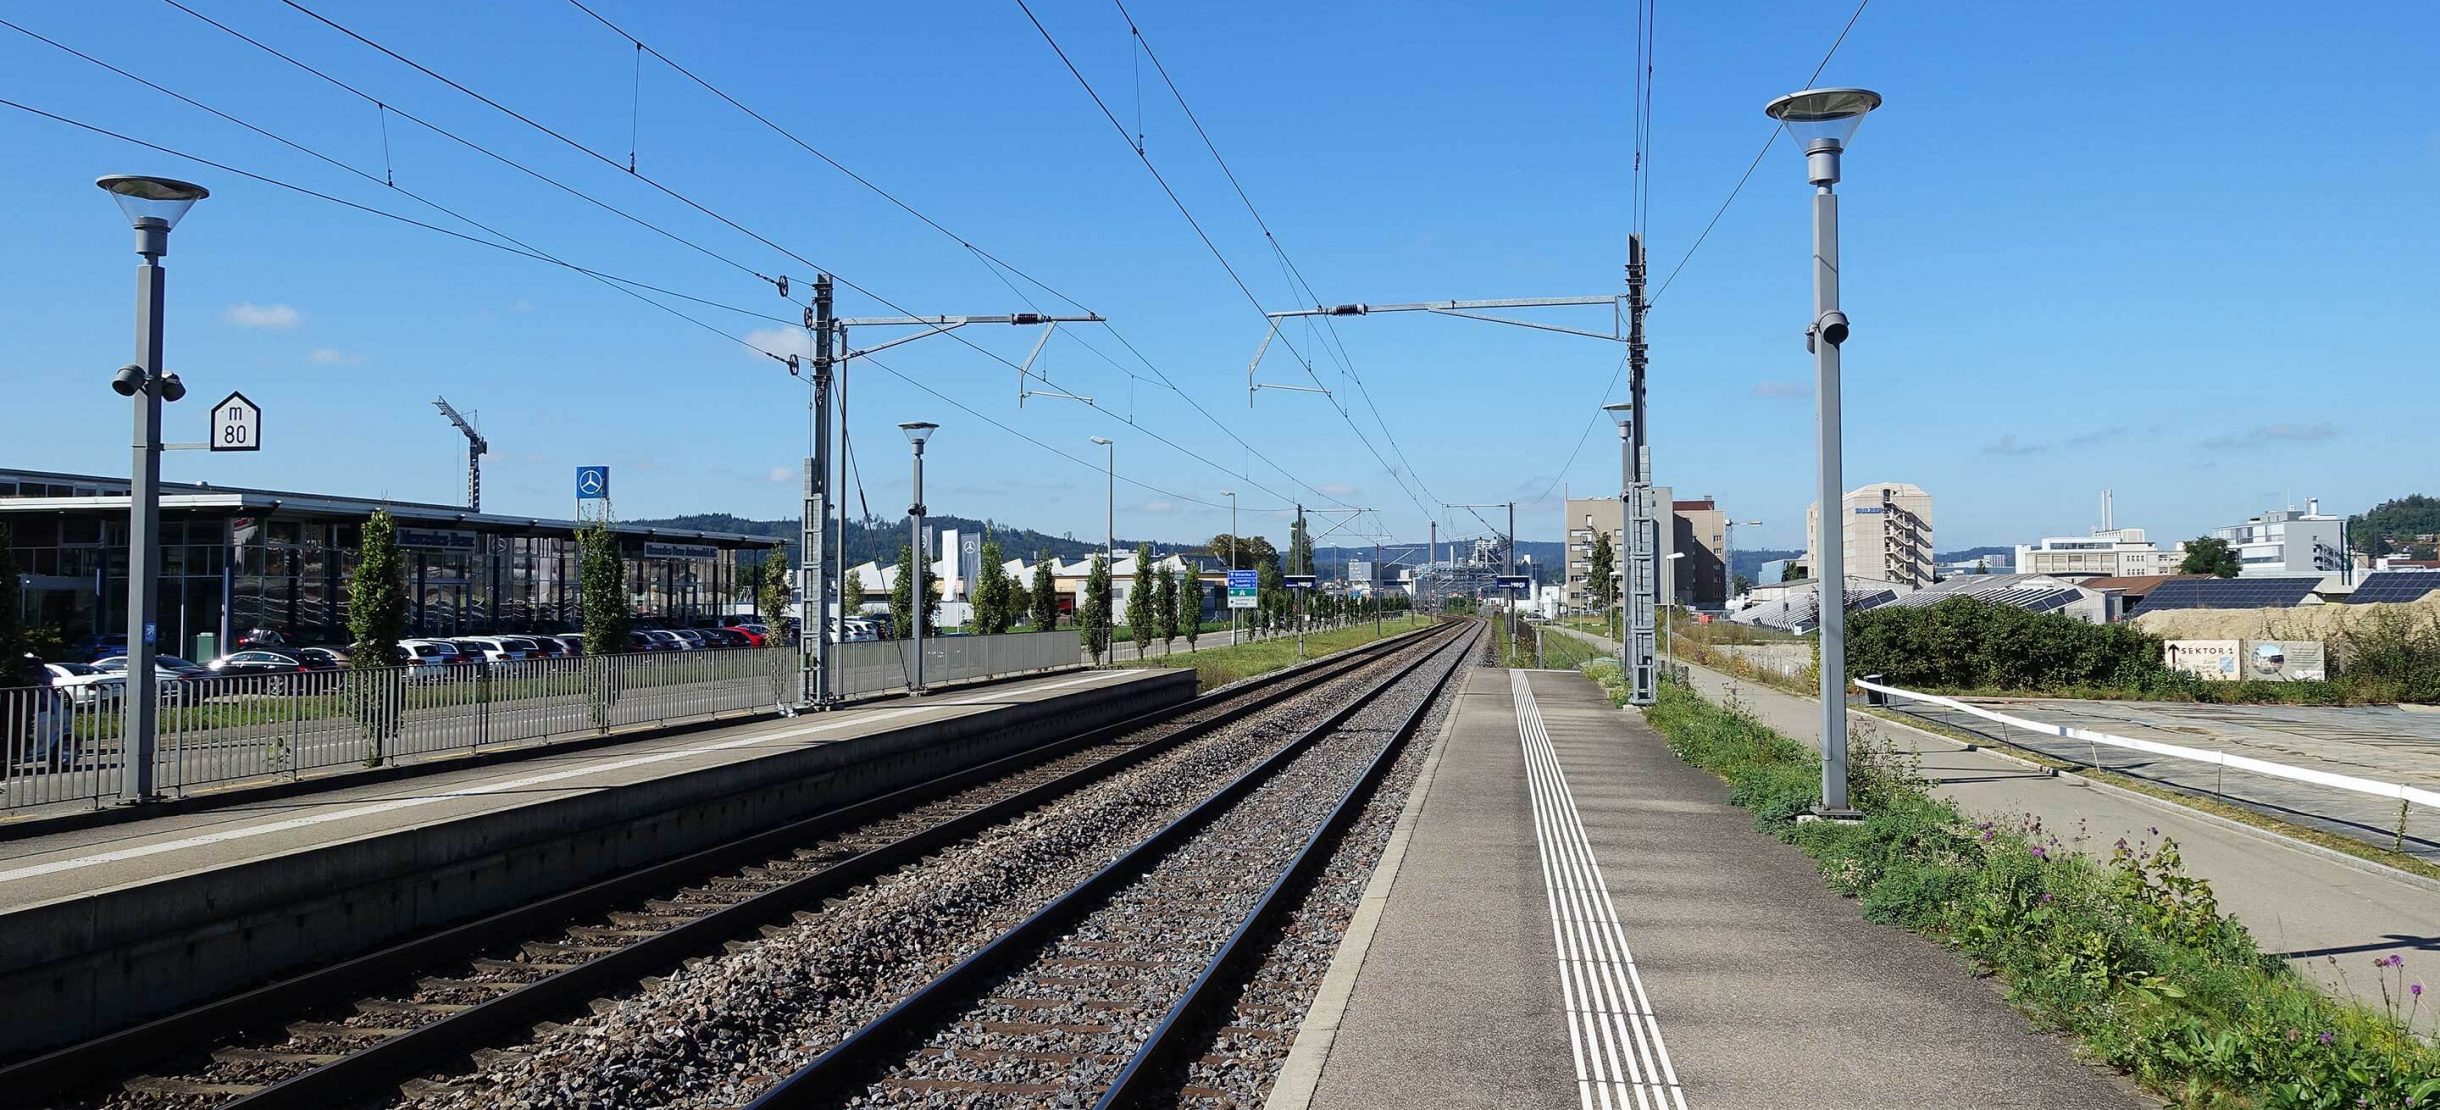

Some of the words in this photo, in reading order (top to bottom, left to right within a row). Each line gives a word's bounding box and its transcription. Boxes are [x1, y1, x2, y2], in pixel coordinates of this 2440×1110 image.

[229, 406, 242, 421] m
[224, 425, 246, 444] 80
[2181, 647, 2225, 655] SEKTOR
[2228, 647, 2234, 655] 1
